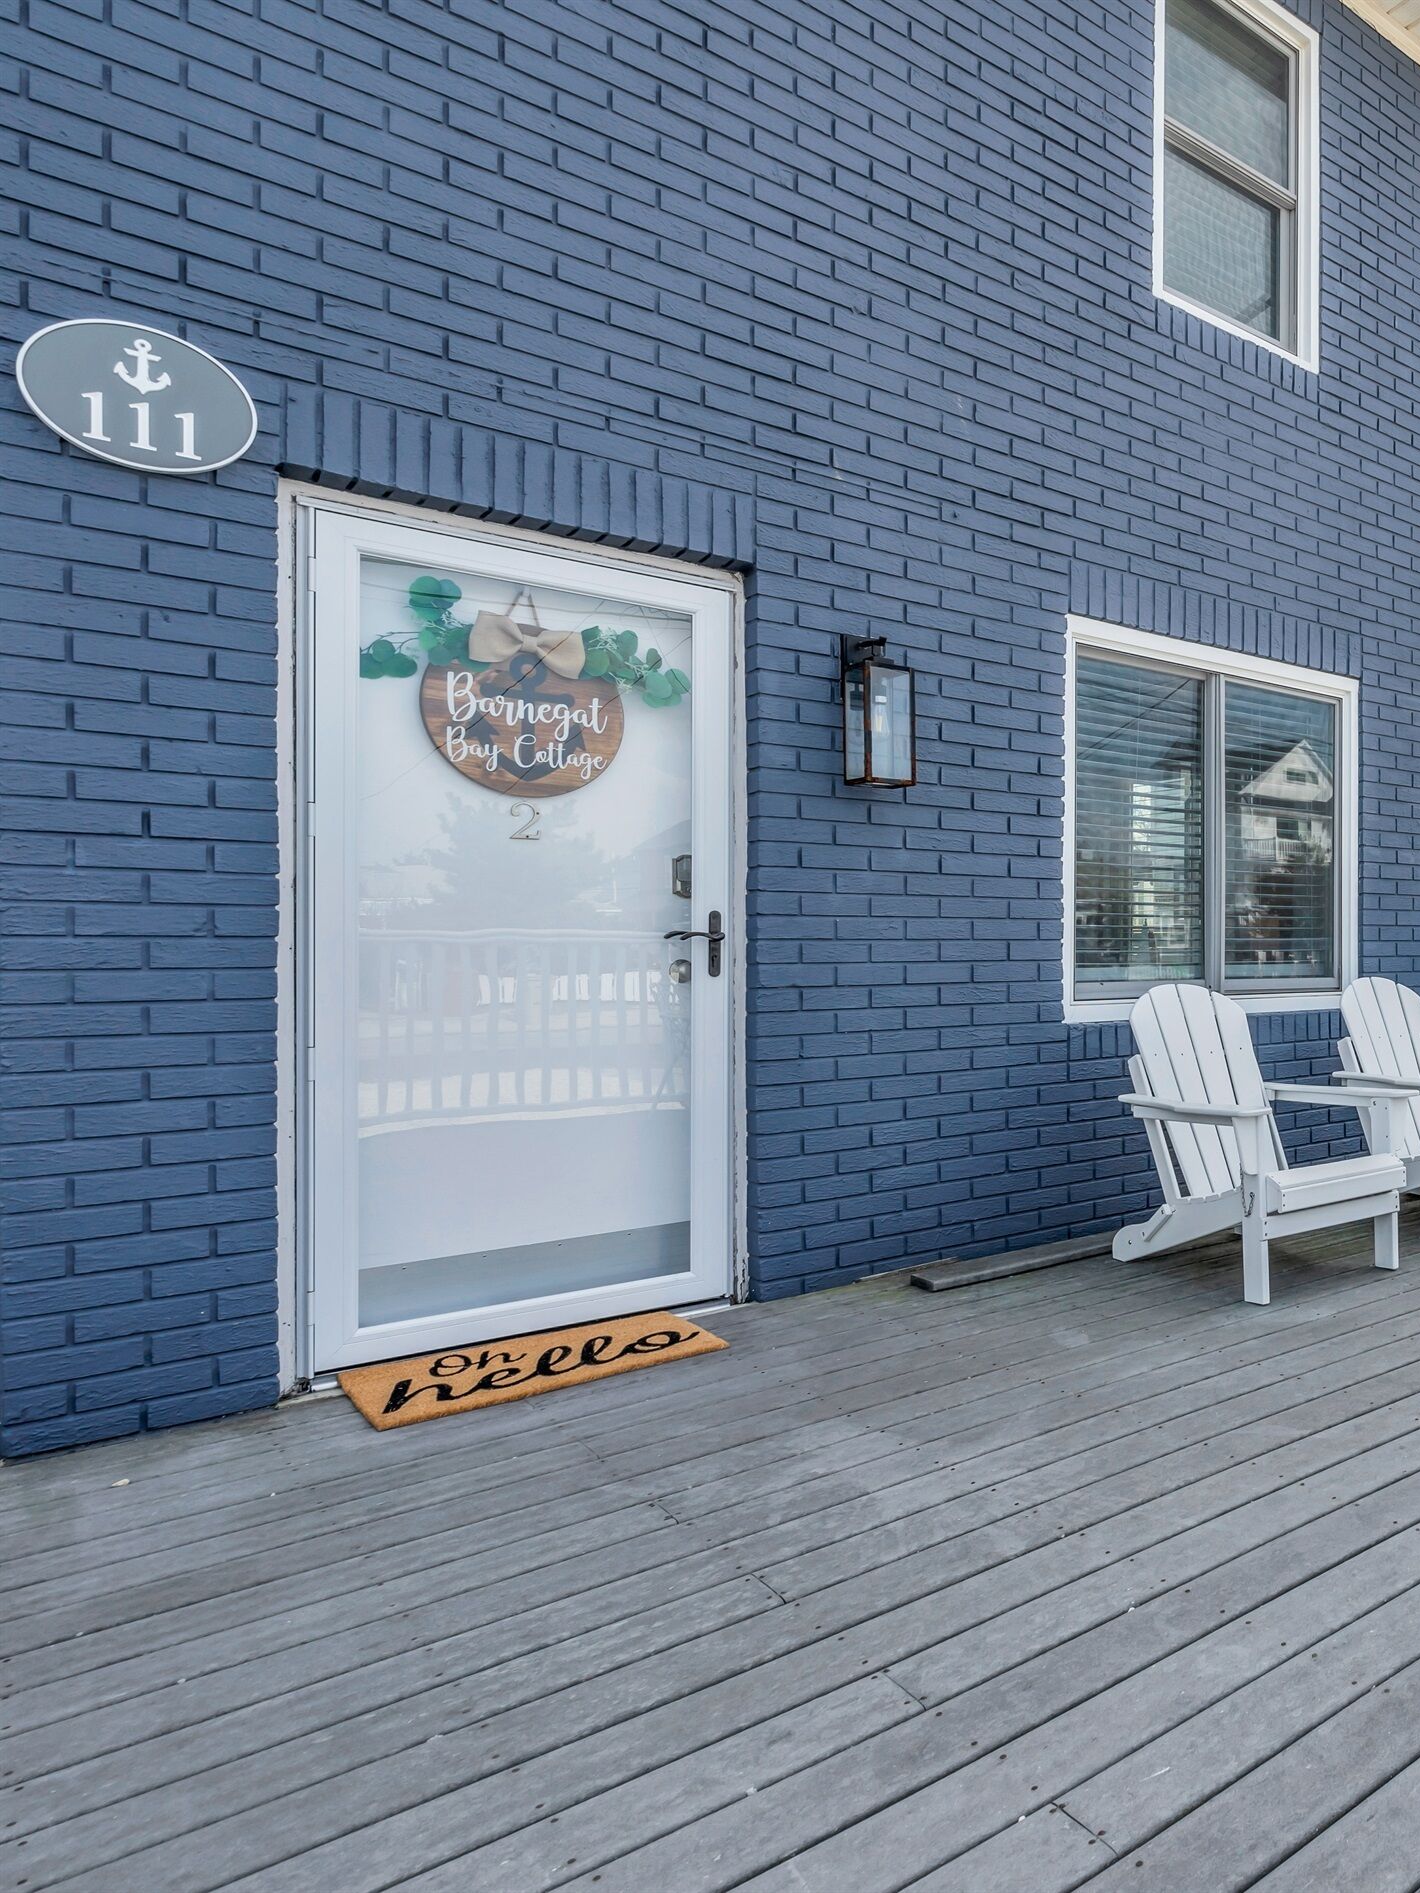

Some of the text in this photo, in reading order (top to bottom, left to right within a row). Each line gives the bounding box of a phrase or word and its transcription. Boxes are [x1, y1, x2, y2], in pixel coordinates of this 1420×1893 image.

[81, 391, 202, 461] 111
[446, 671, 608, 741] Barnegat
[446, 726, 608, 779] Bay Cottage
[509, 801, 542, 840] 2
[382, 1331, 700, 1414] hello
